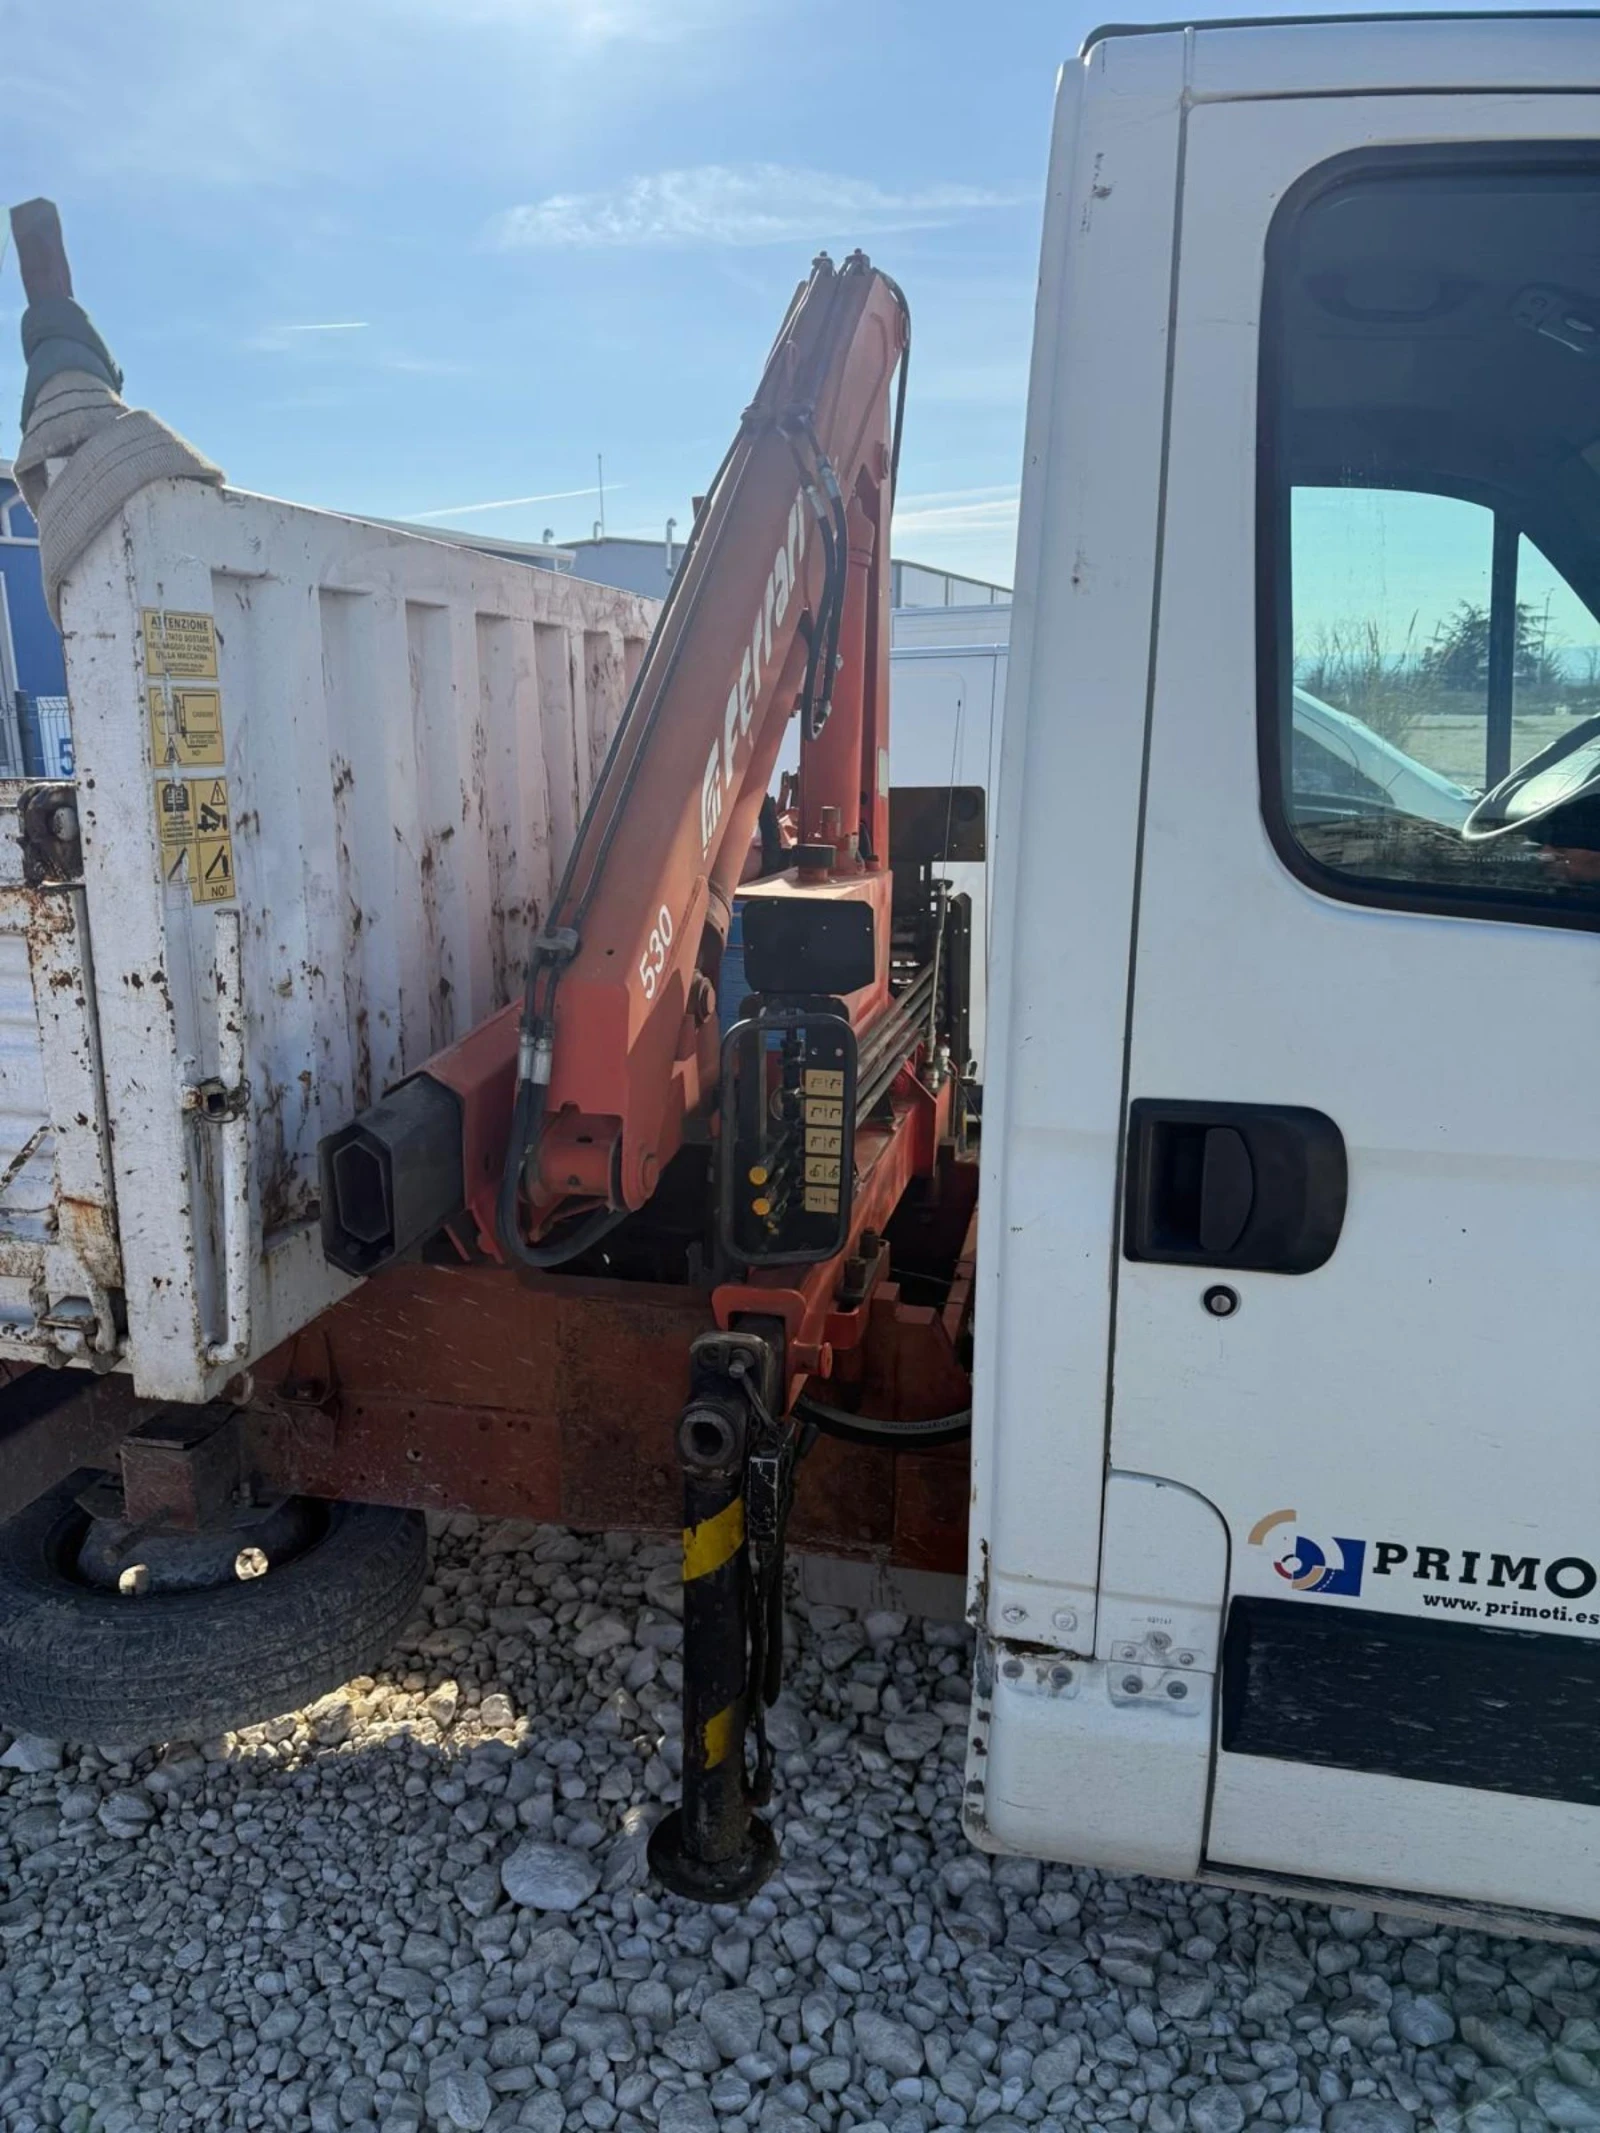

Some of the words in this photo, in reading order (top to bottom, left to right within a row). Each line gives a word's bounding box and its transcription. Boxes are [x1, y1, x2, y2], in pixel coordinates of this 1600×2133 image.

[639, 904, 673, 999] 530
[1372, 1541, 1598, 1600] PRIMO
[1422, 1593, 1600, 1626] www.primoti.es
